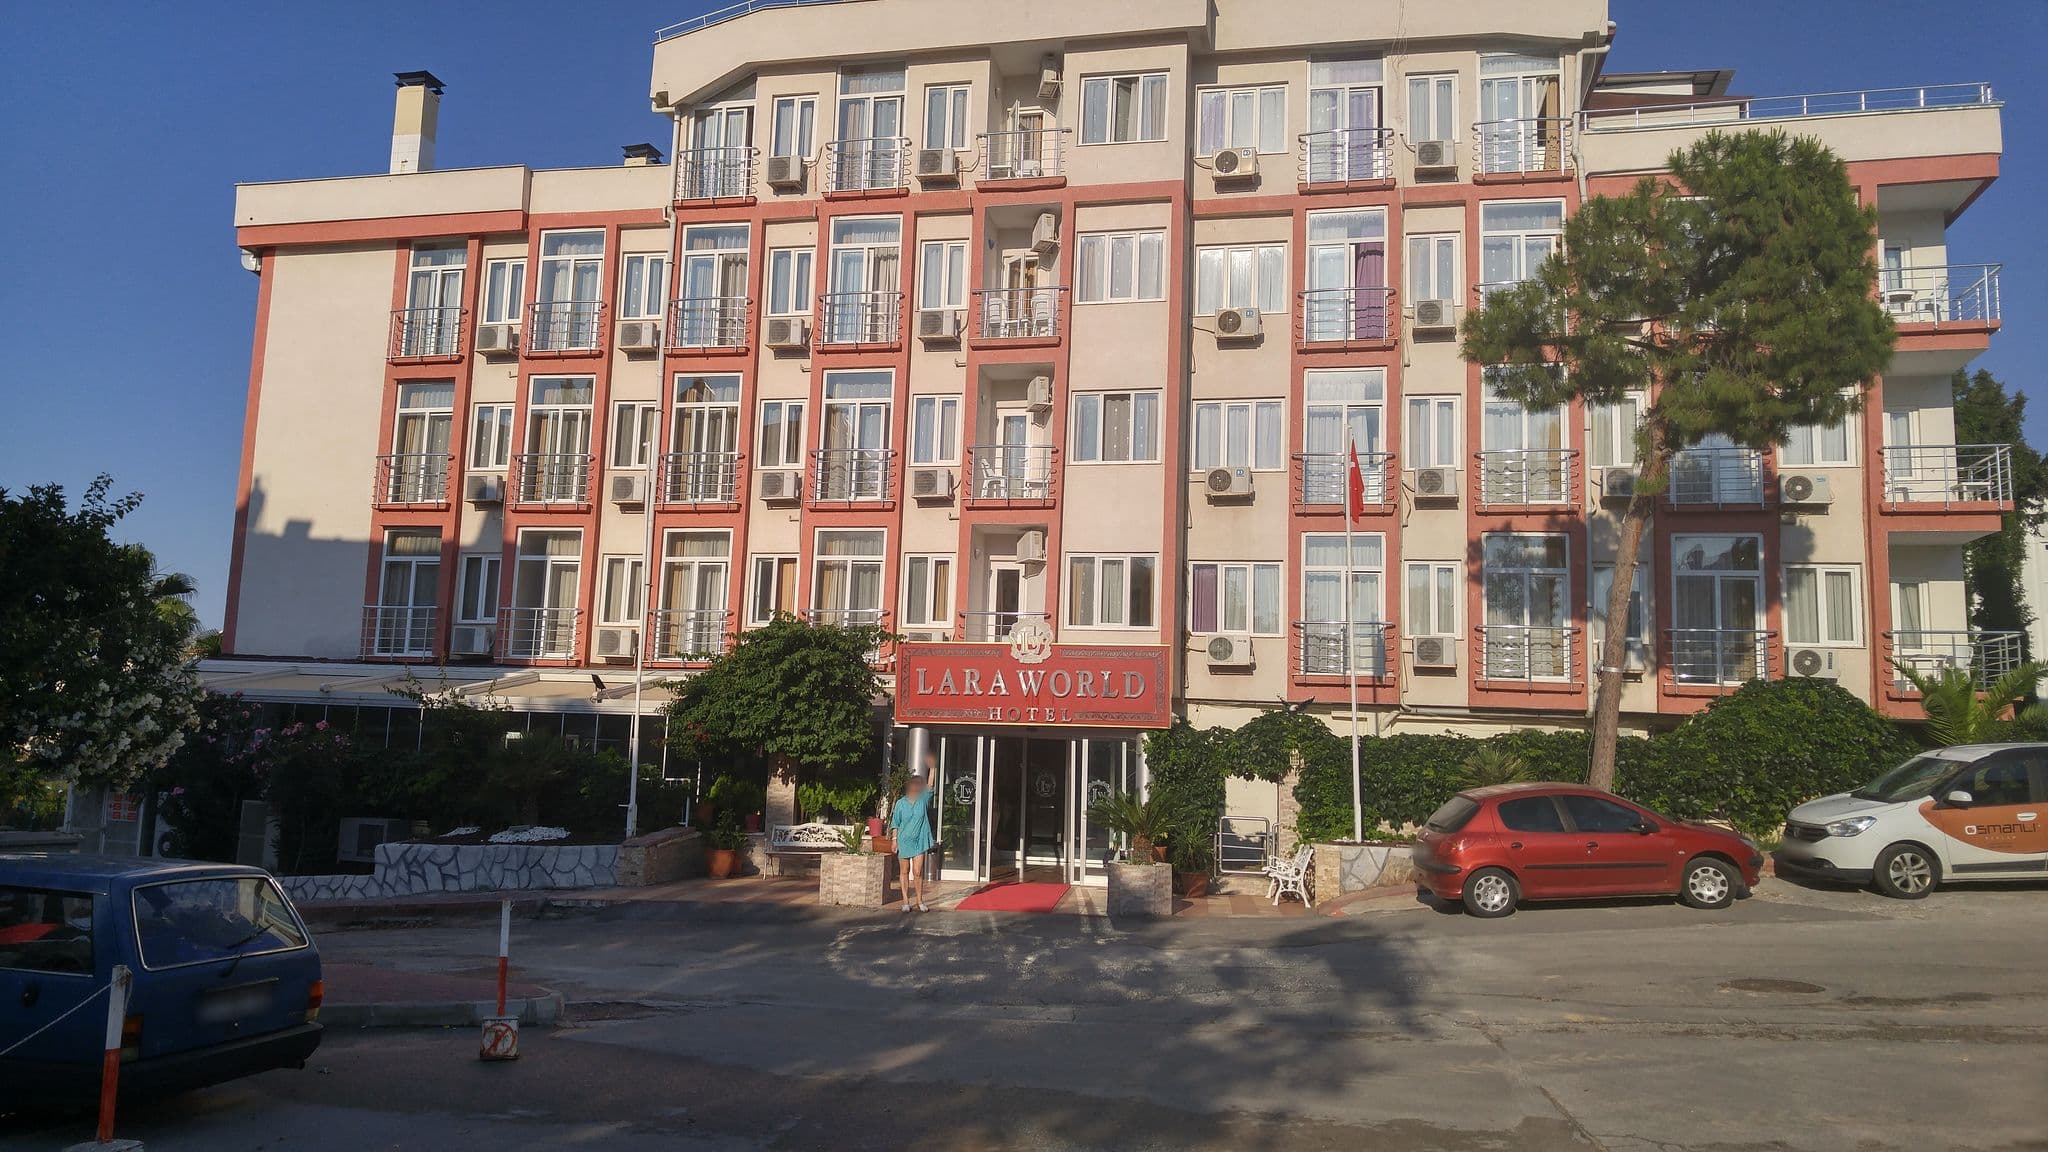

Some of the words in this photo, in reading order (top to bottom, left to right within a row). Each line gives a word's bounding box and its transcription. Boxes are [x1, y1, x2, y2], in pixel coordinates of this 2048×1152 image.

[916, 667, 1010, 697] LARA
[1016, 669, 1147, 699] WORLD
[987, 706, 1073, 723] HOTEL
